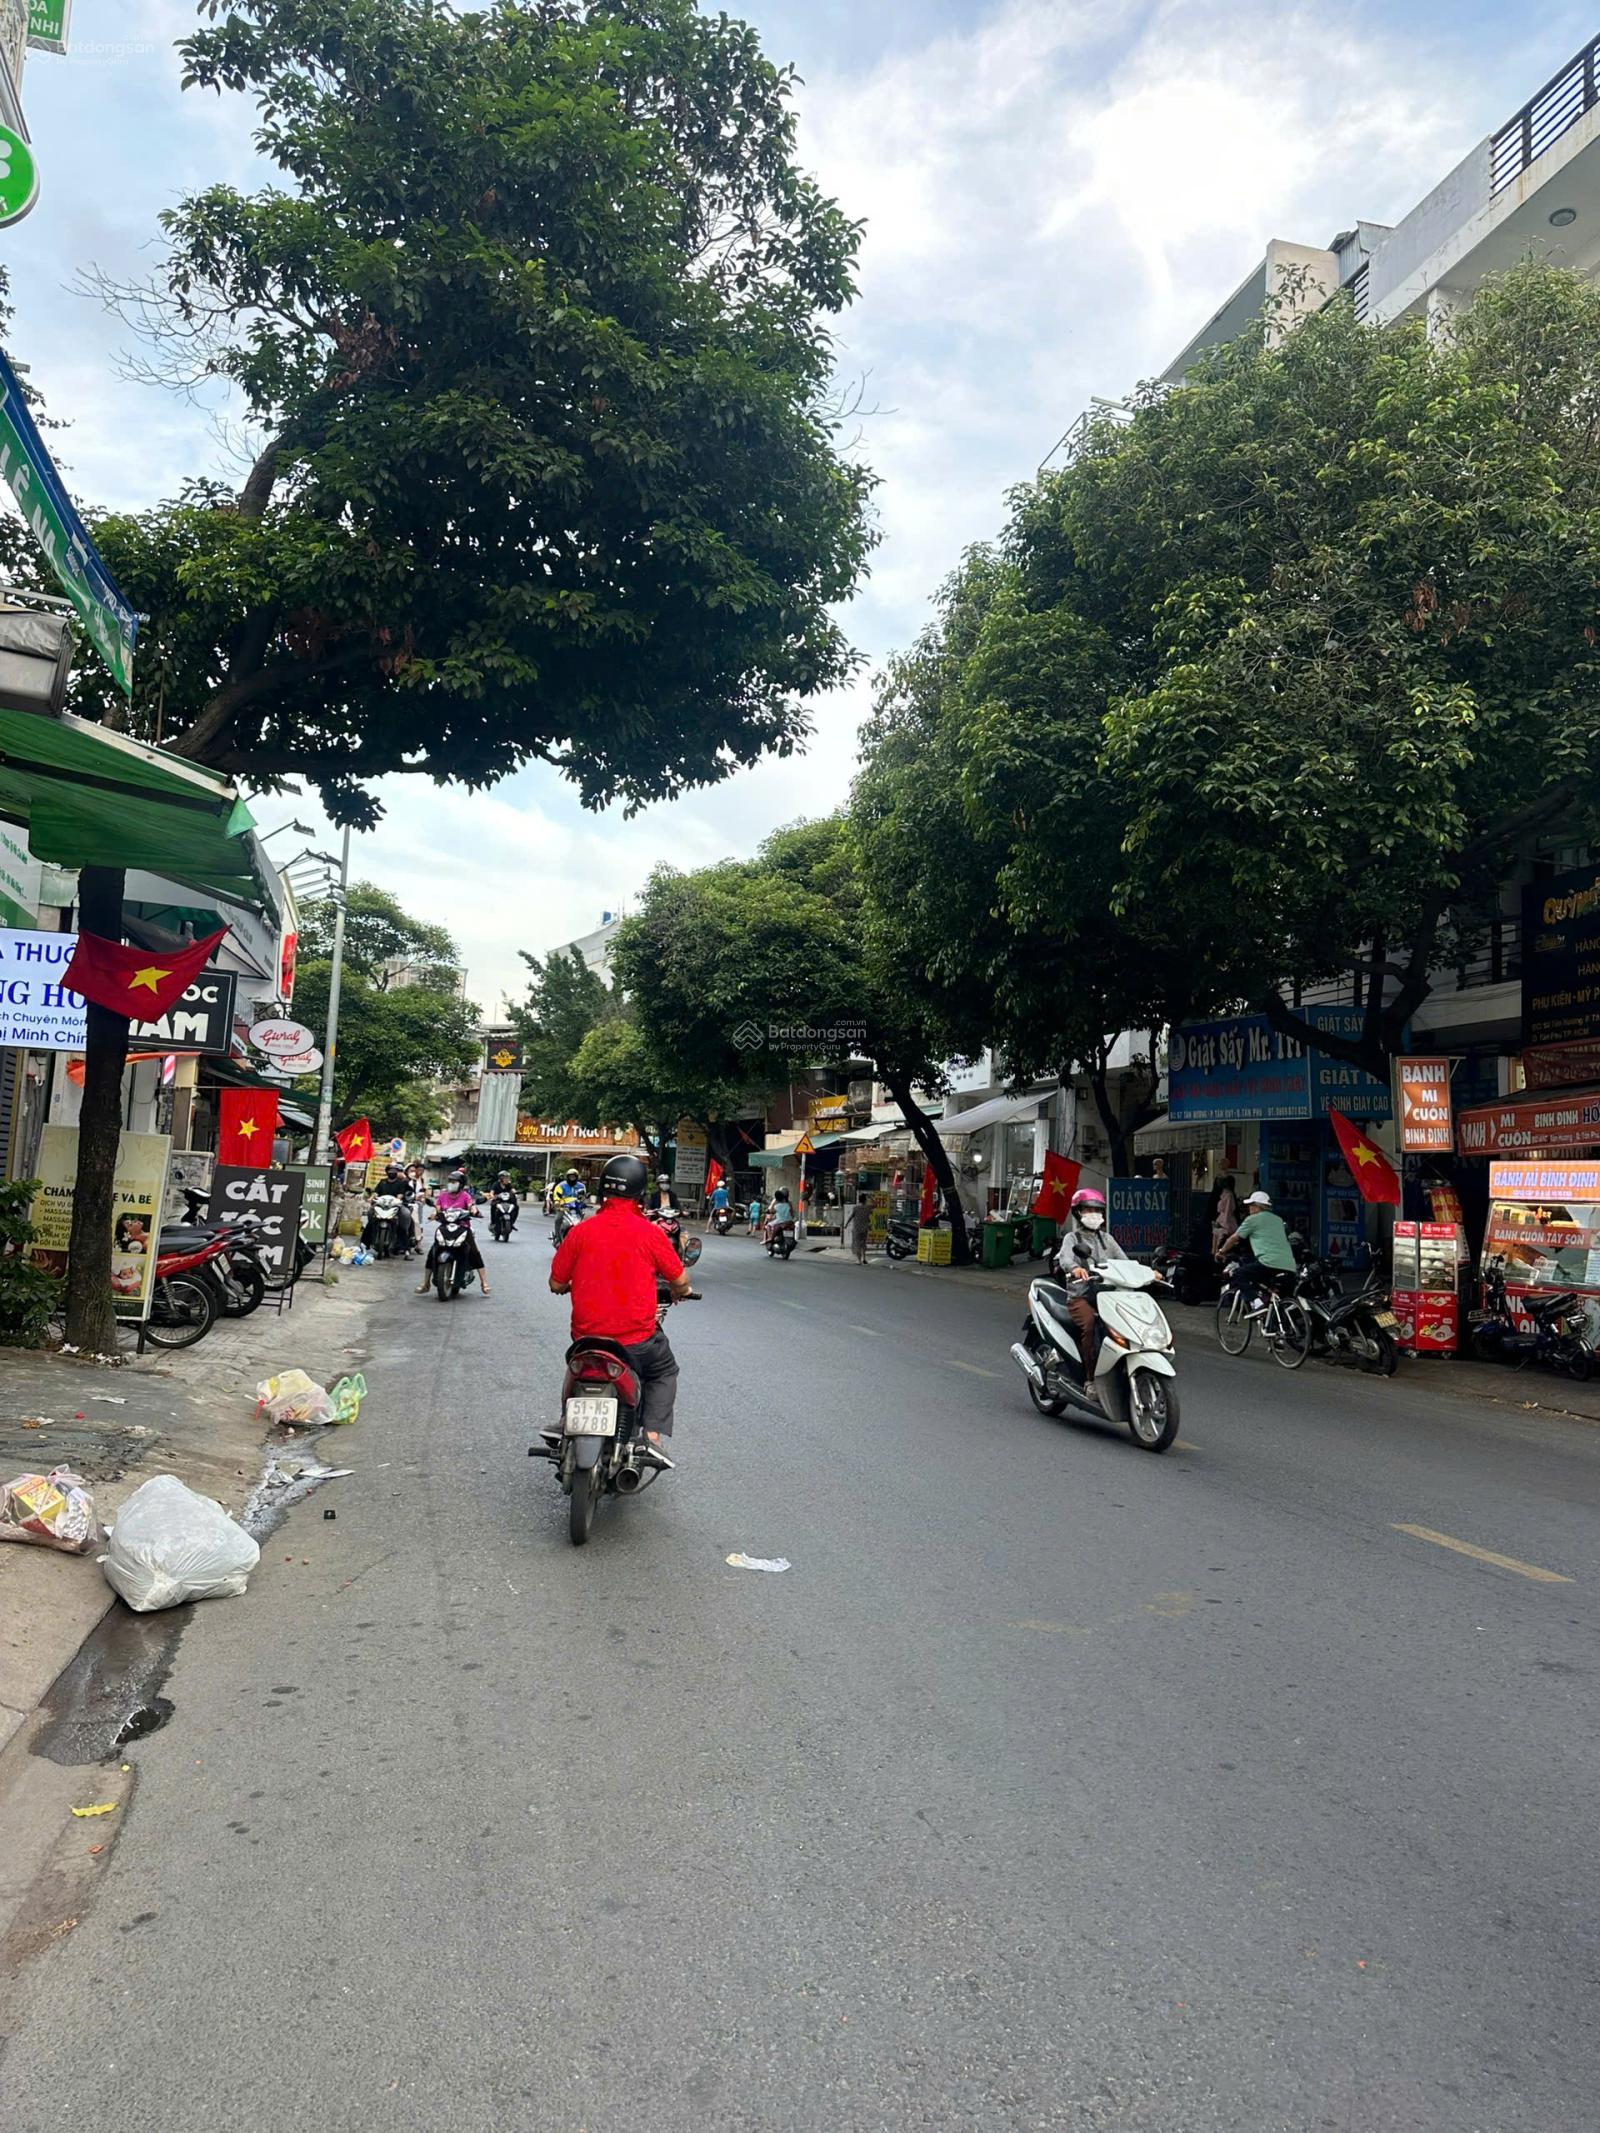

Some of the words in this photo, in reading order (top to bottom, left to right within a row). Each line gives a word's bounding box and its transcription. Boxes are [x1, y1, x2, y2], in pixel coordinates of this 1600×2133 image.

[30, 17, 58, 34] NHI
[13, 1012, 58, 1025] Chuyên
[12, 1027, 49, 1042] Minh
[1248, 1026, 1272, 1063] Mr.
[225, 1174, 289, 1204] CẮT
[305, 1179, 326, 1189] SINH
